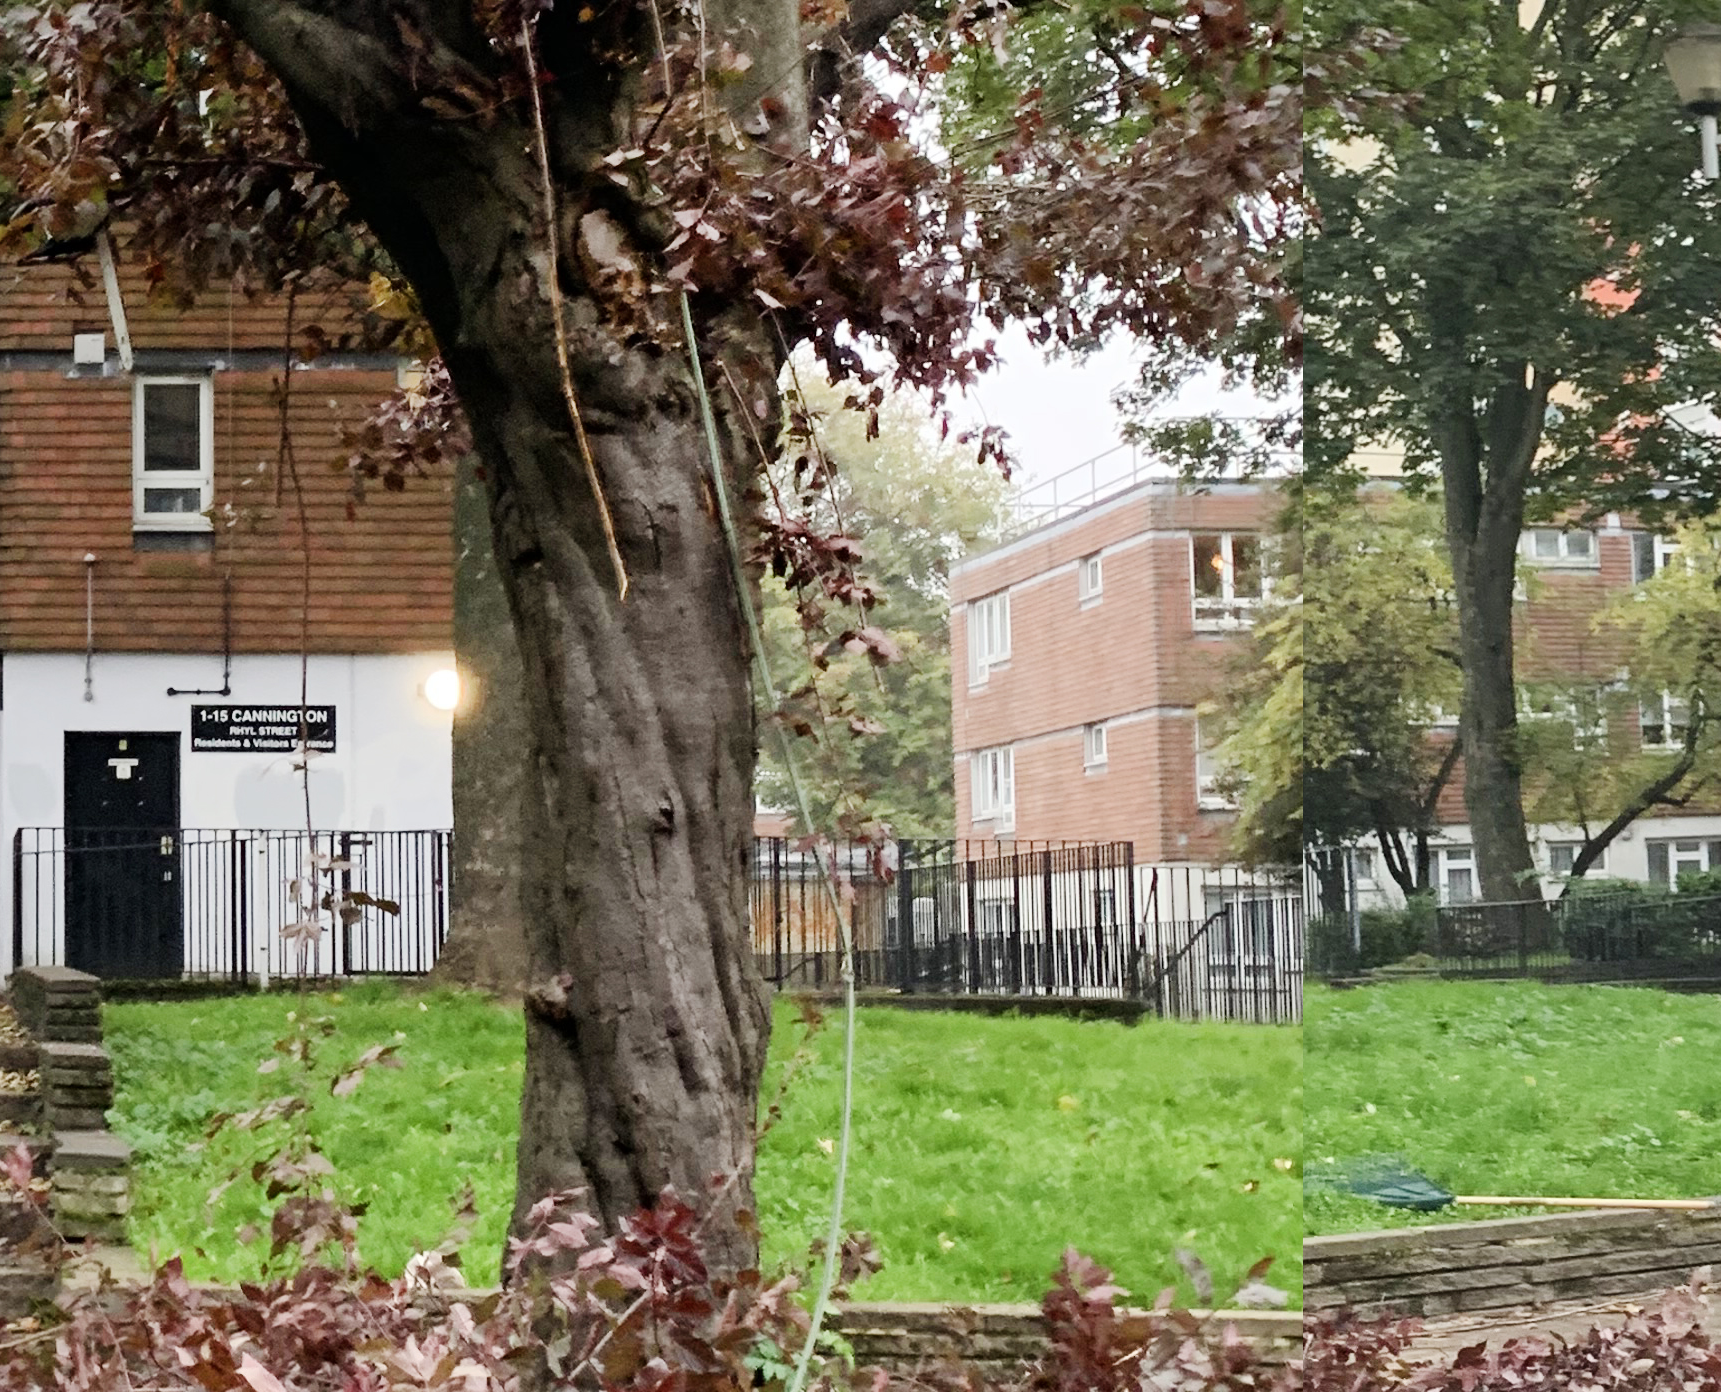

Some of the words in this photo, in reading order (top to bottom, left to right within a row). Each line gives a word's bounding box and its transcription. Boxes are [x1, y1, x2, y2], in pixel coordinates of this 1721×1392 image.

[200, 710, 228, 722] 1-15
[232, 710, 327, 723] CANNINGTON
[229, 726, 257, 735] RHYL
[259, 726, 298, 736] STREET
[194, 738, 241, 748] Residents
[243, 739, 251, 748] &
[253, 738, 289, 747] Visitors
